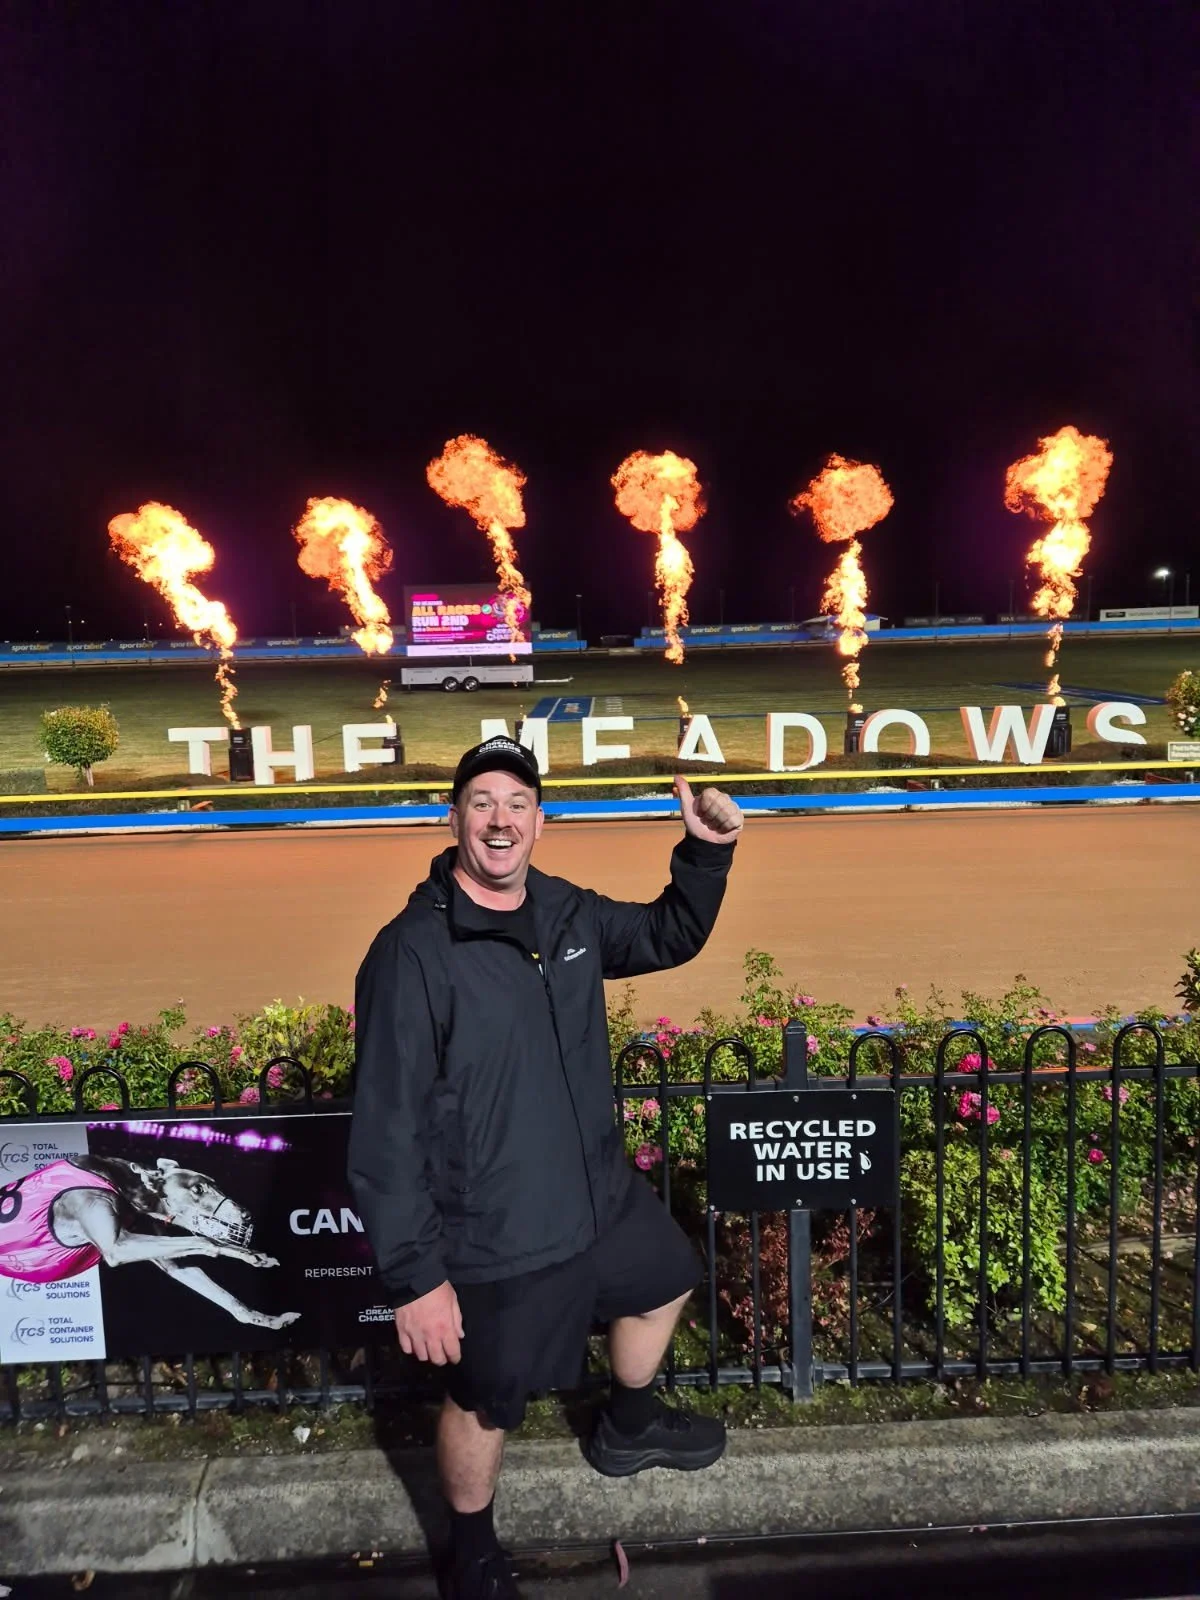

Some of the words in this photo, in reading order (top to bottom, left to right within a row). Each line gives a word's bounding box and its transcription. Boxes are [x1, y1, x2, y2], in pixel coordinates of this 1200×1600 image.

[412, 615, 440, 627] RUN
[441, 615, 469, 627] 2ND
[538, 631, 571, 640] sportsbet
[11, 643, 53, 652] sportsbet
[66, 643, 107, 652] sportsbet
[119, 640, 157, 650] sportsbet
[168, 723, 397, 785] THE
[481, 702, 1147, 775] MEADOWS
[730, 1120, 876, 1140] RECYCLED
[753, 1141, 852, 1160] WATER
[3, 1153, 29, 1163] TCS
[756, 1164, 785, 1182] IN
[797, 1162, 850, 1180] USE
[304, 1266, 374, 1278] REPRESENT
[16, 1283, 41, 1293] TCS
[45, 1281, 90, 1290] CONTAINER
[46, 1290, 91, 1299] SOLUTIONS
[48, 1317, 73, 1325] TOTAL
[19, 1327, 46, 1337] TCS
[49, 1326, 94, 1334] CONTAINER
[50, 1335, 94, 1344] SOLUTIONS
